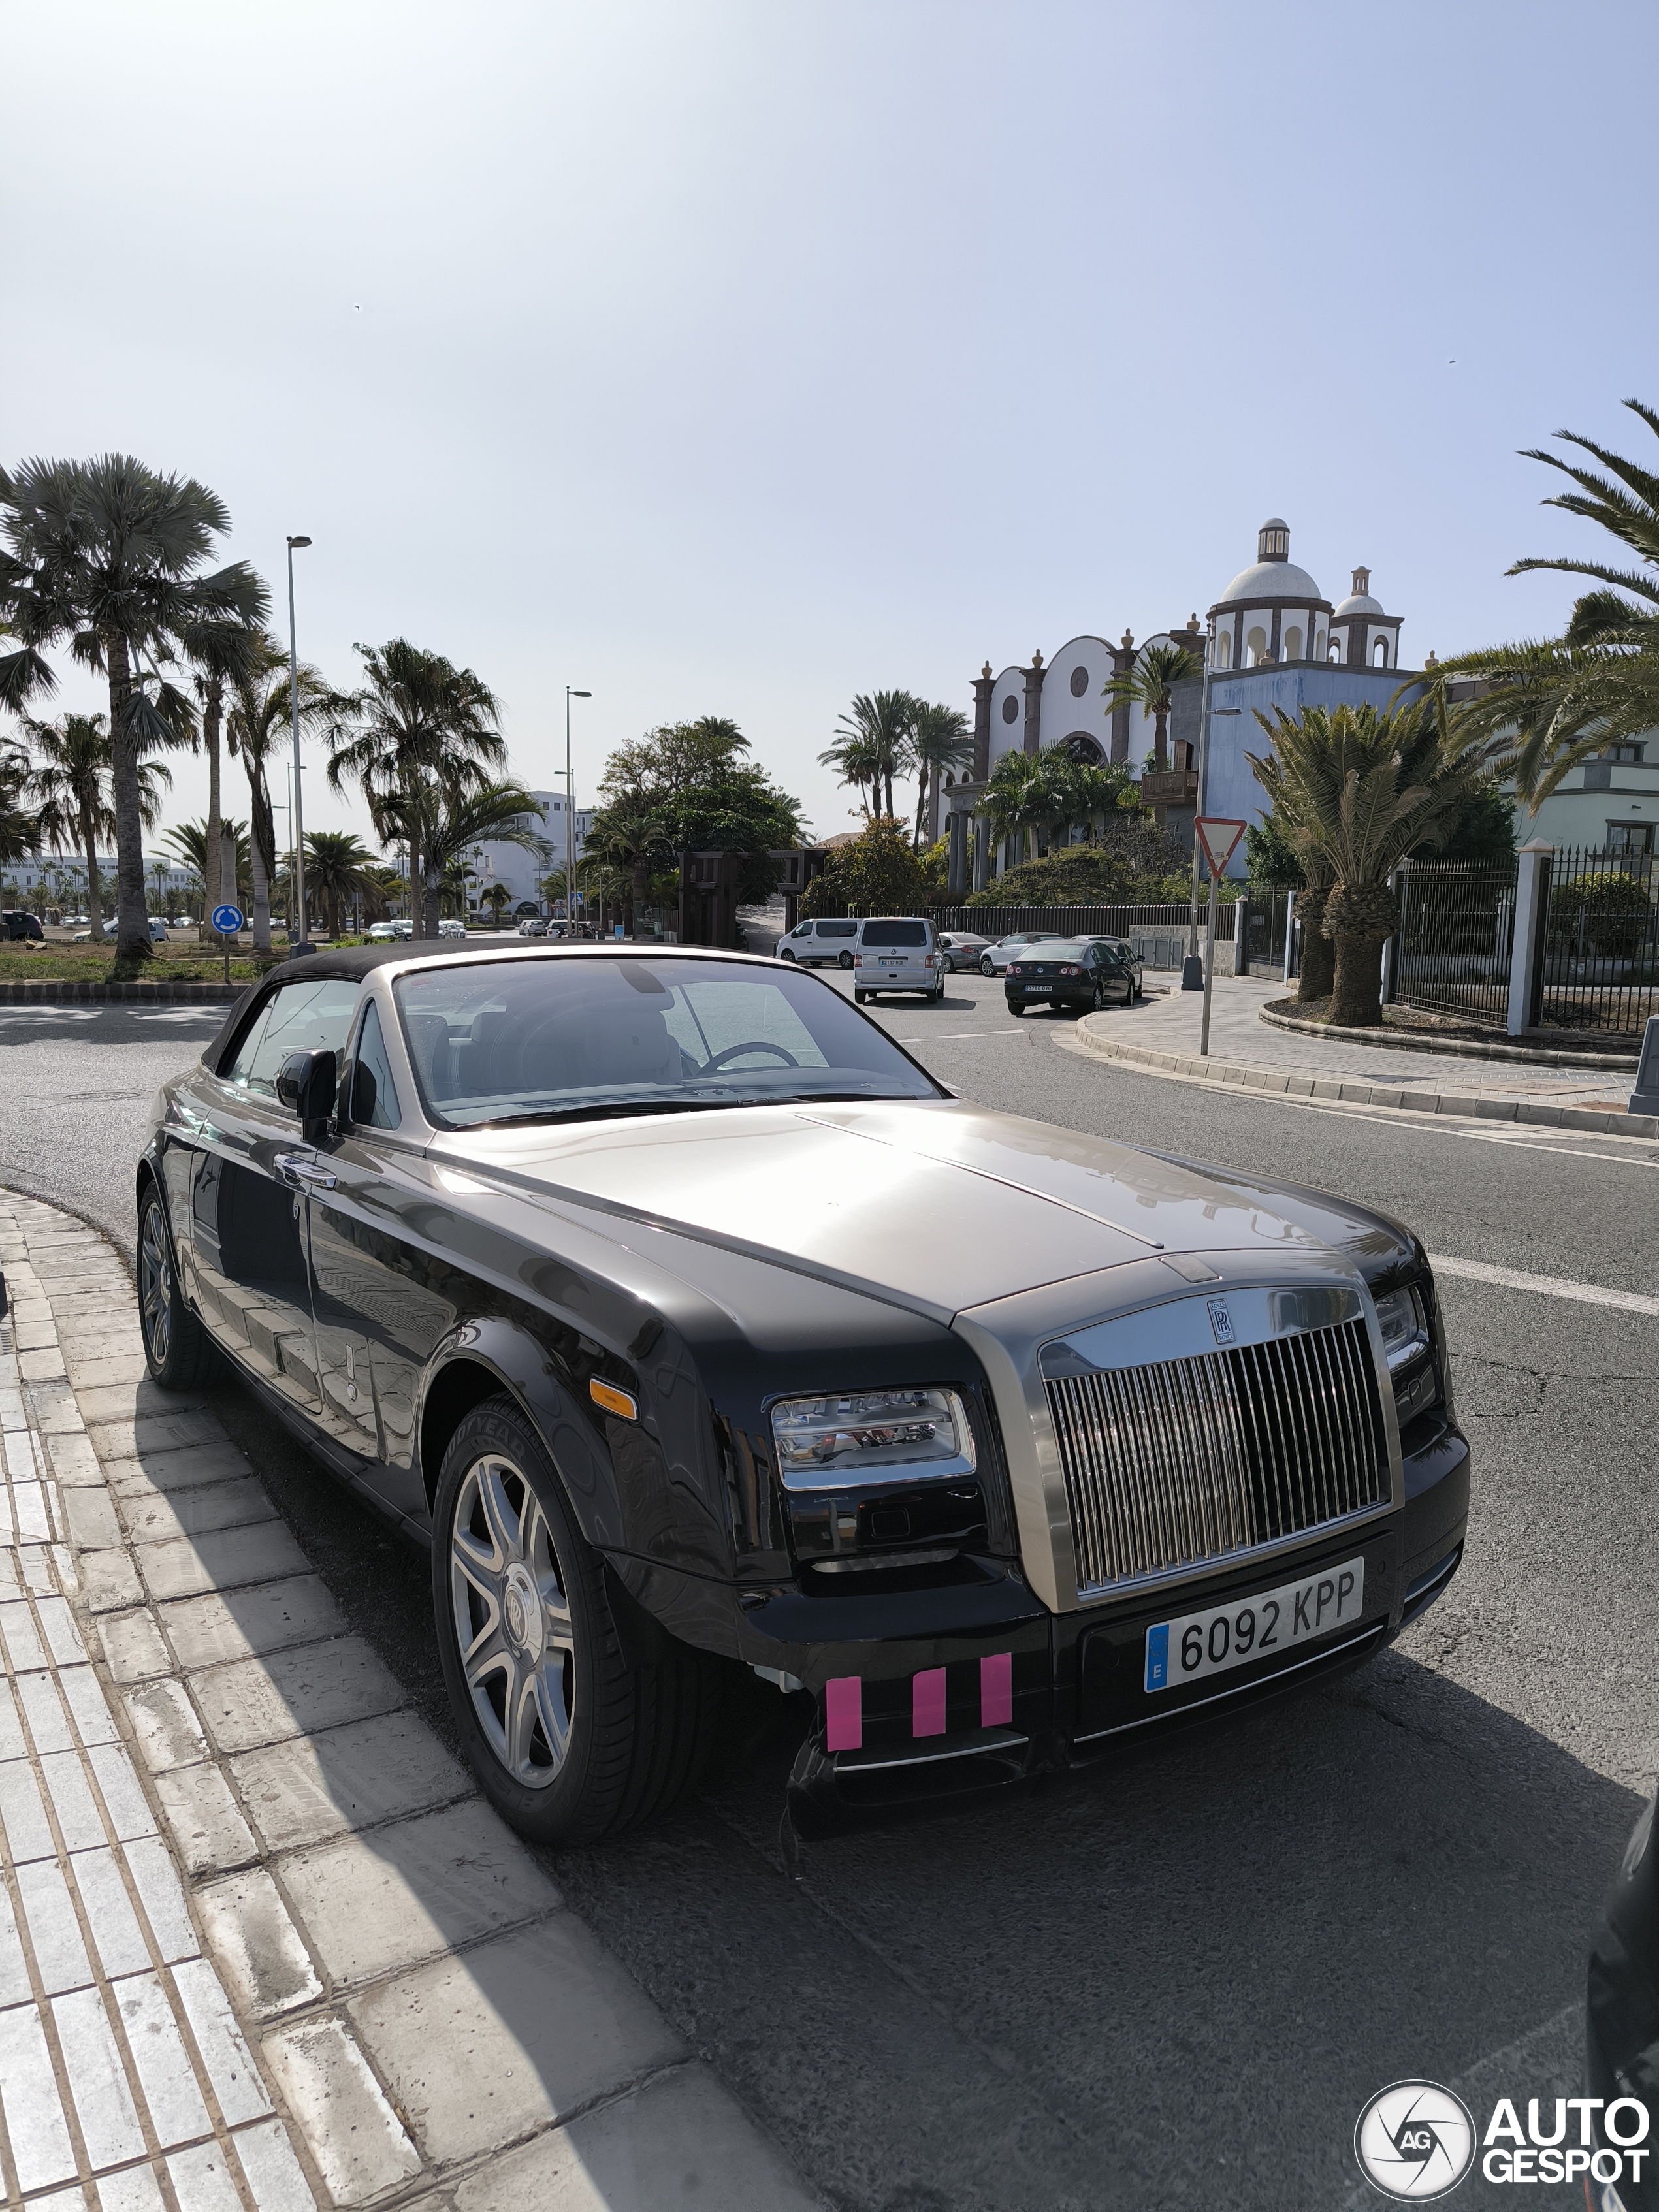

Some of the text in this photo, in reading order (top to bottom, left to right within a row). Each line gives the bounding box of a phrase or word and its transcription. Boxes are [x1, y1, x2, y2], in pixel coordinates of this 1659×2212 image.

[1181, 1571, 1355, 1672] 6092 KPP
[1153, 1663, 1162, 1679] E
